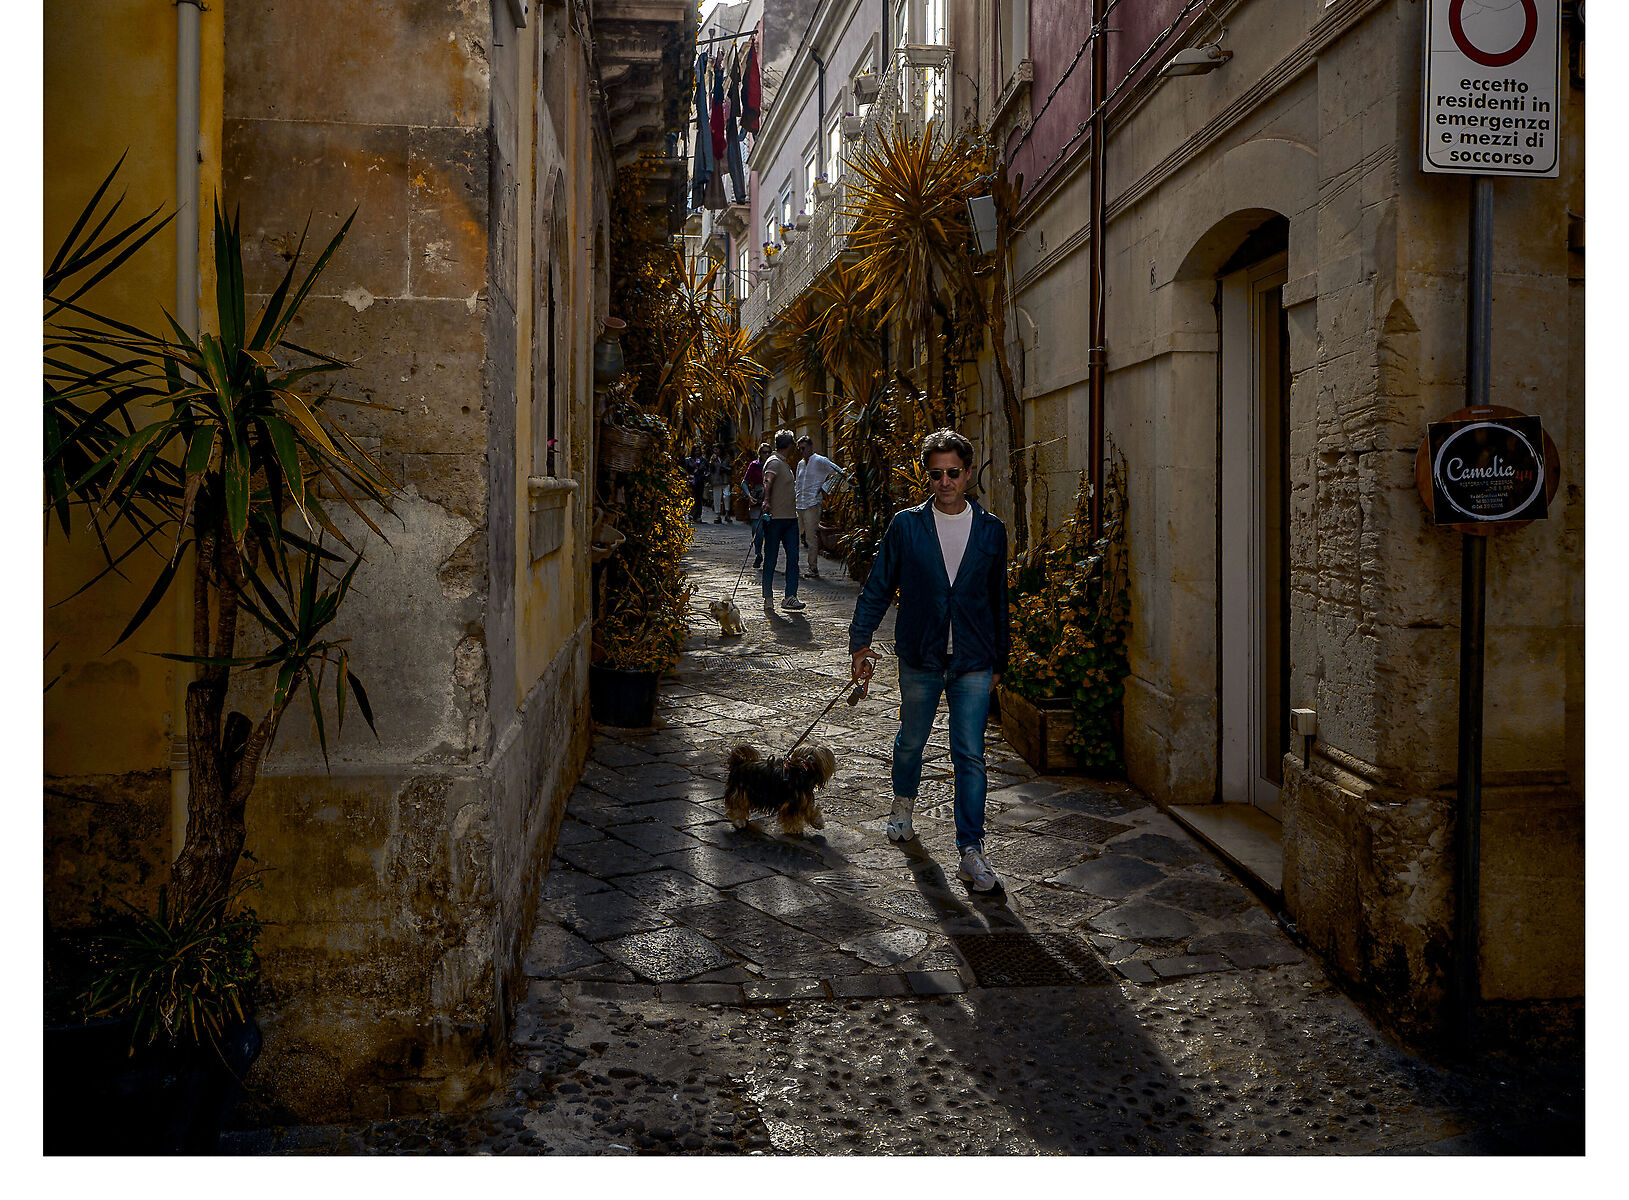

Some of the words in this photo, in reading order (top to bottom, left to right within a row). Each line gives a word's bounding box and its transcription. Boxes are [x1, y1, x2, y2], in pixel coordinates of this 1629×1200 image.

[1460, 78, 1529, 93] eccetto
[1436, 92, 1525, 111] residenti
[1532, 96, 1550, 113] in
[1435, 113, 1550, 131] emergenza
[1441, 131, 1453, 144] e
[1460, 131, 1518, 147] mezzi
[1525, 132, 1544, 148] di
[1449, 150, 1534, 165] soccorso
[1447, 455, 1516, 481] Camelia
